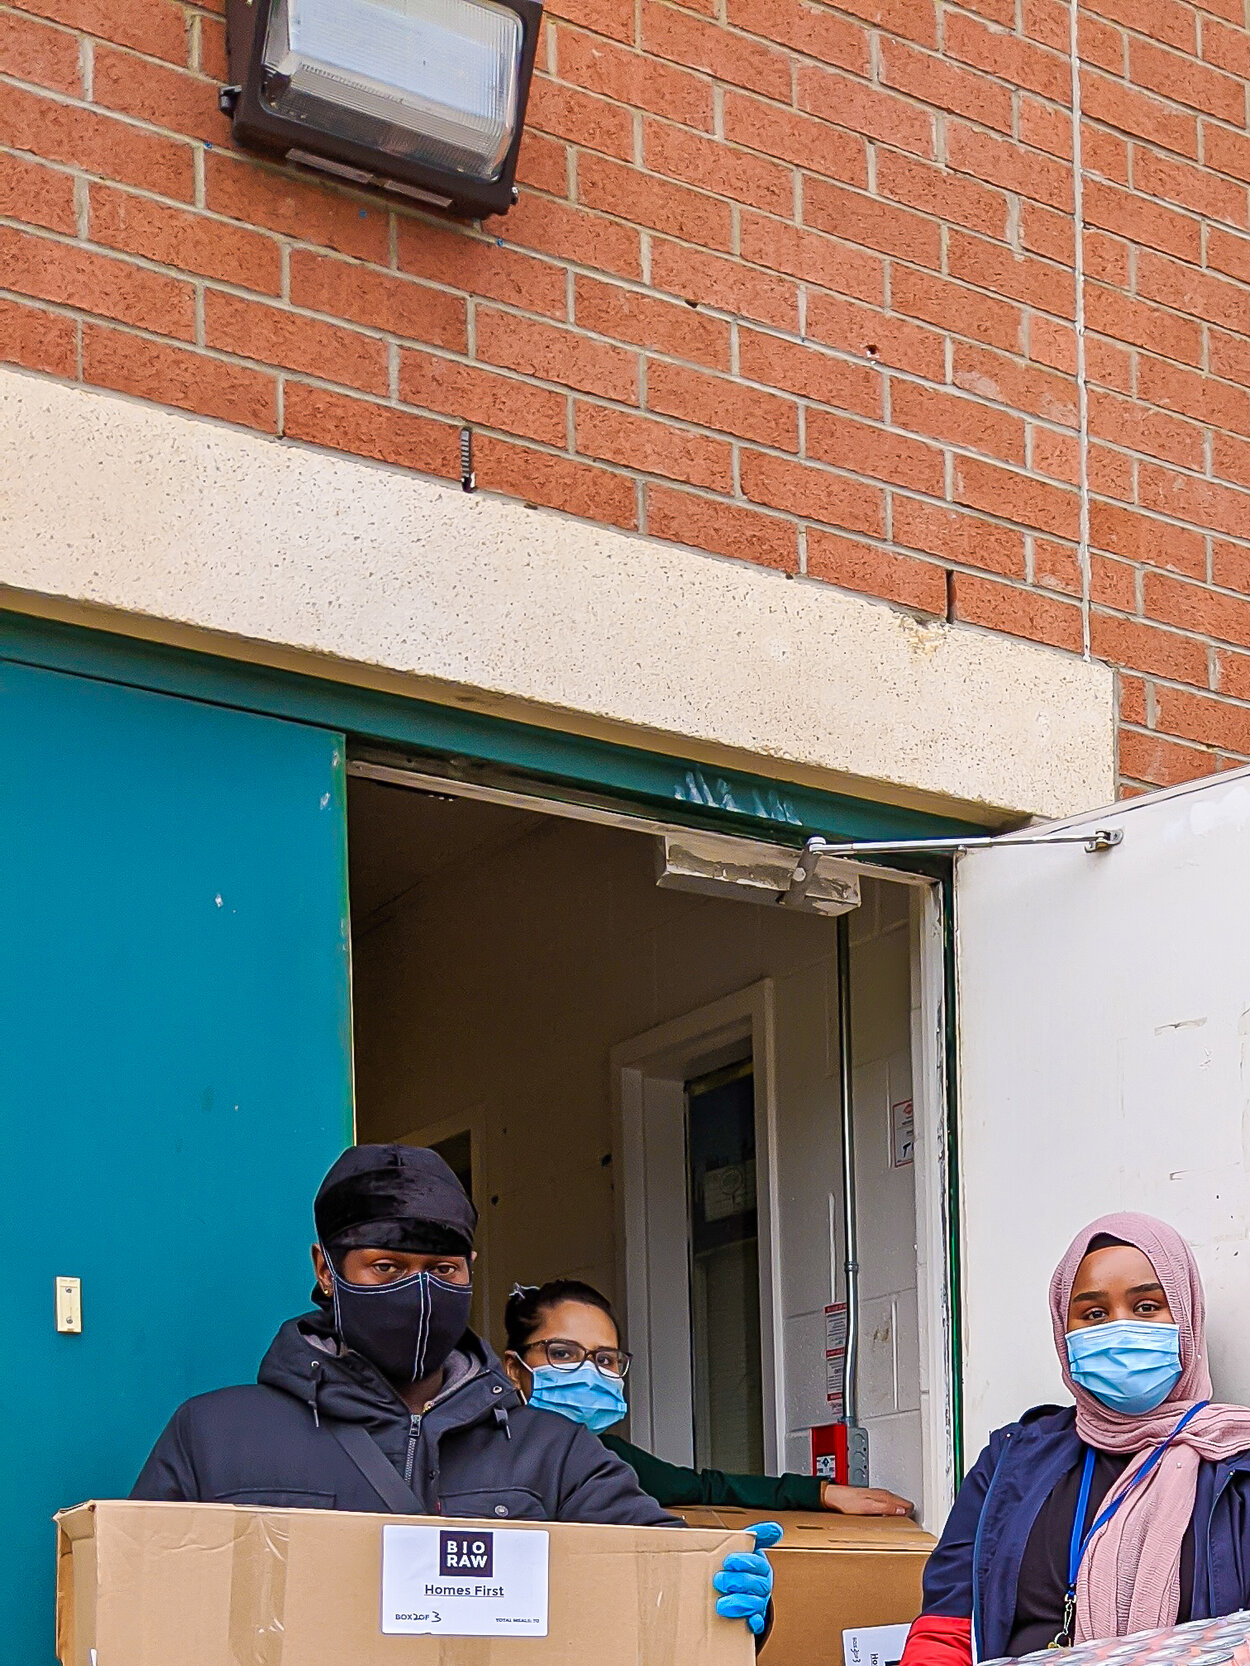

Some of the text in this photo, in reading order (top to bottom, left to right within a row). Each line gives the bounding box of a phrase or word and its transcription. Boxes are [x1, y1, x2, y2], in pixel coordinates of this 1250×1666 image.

[446, 1540, 486, 1554] BIO
[446, 1554, 488, 1568] RAW
[425, 1584, 505, 1597] Homes First
[431, 1611, 442, 1622] 3
